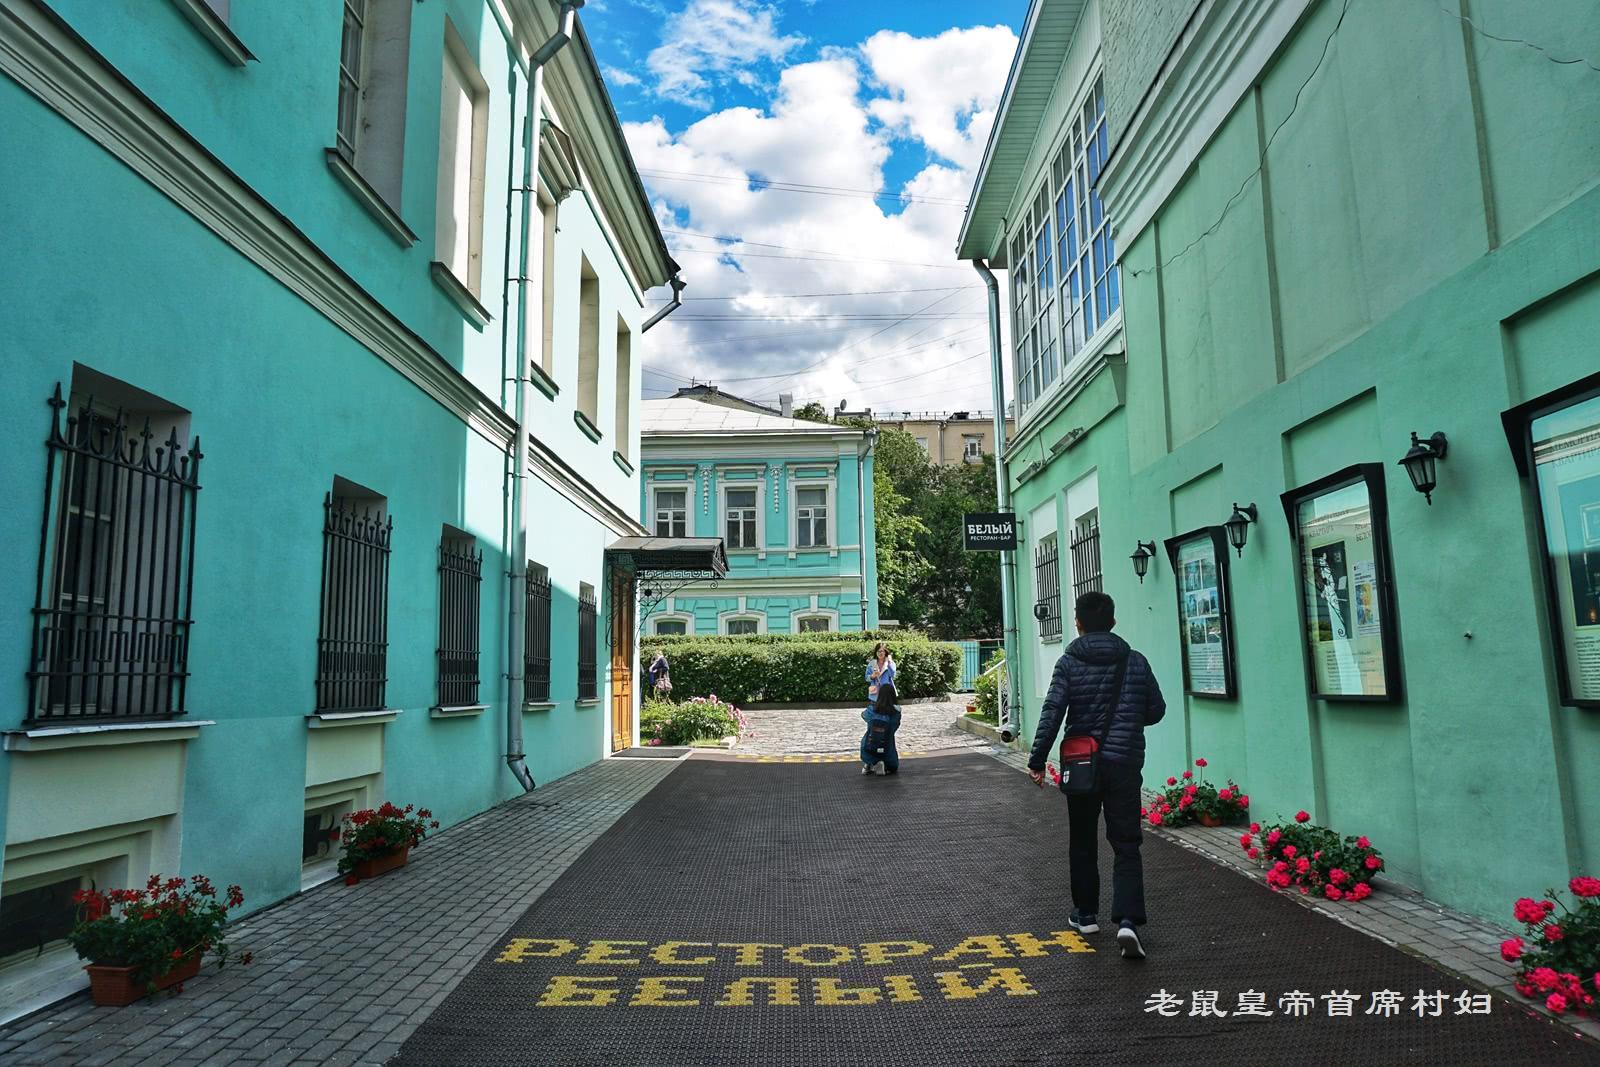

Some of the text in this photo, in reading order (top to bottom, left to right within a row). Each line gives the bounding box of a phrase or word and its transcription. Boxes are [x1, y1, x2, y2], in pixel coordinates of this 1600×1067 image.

[968, 522, 1013, 534] БЕЛЫЙ
[494, 929, 1097, 965] РЕСТОРАН
[535, 962, 1038, 1007] БЕЛЫЙ
